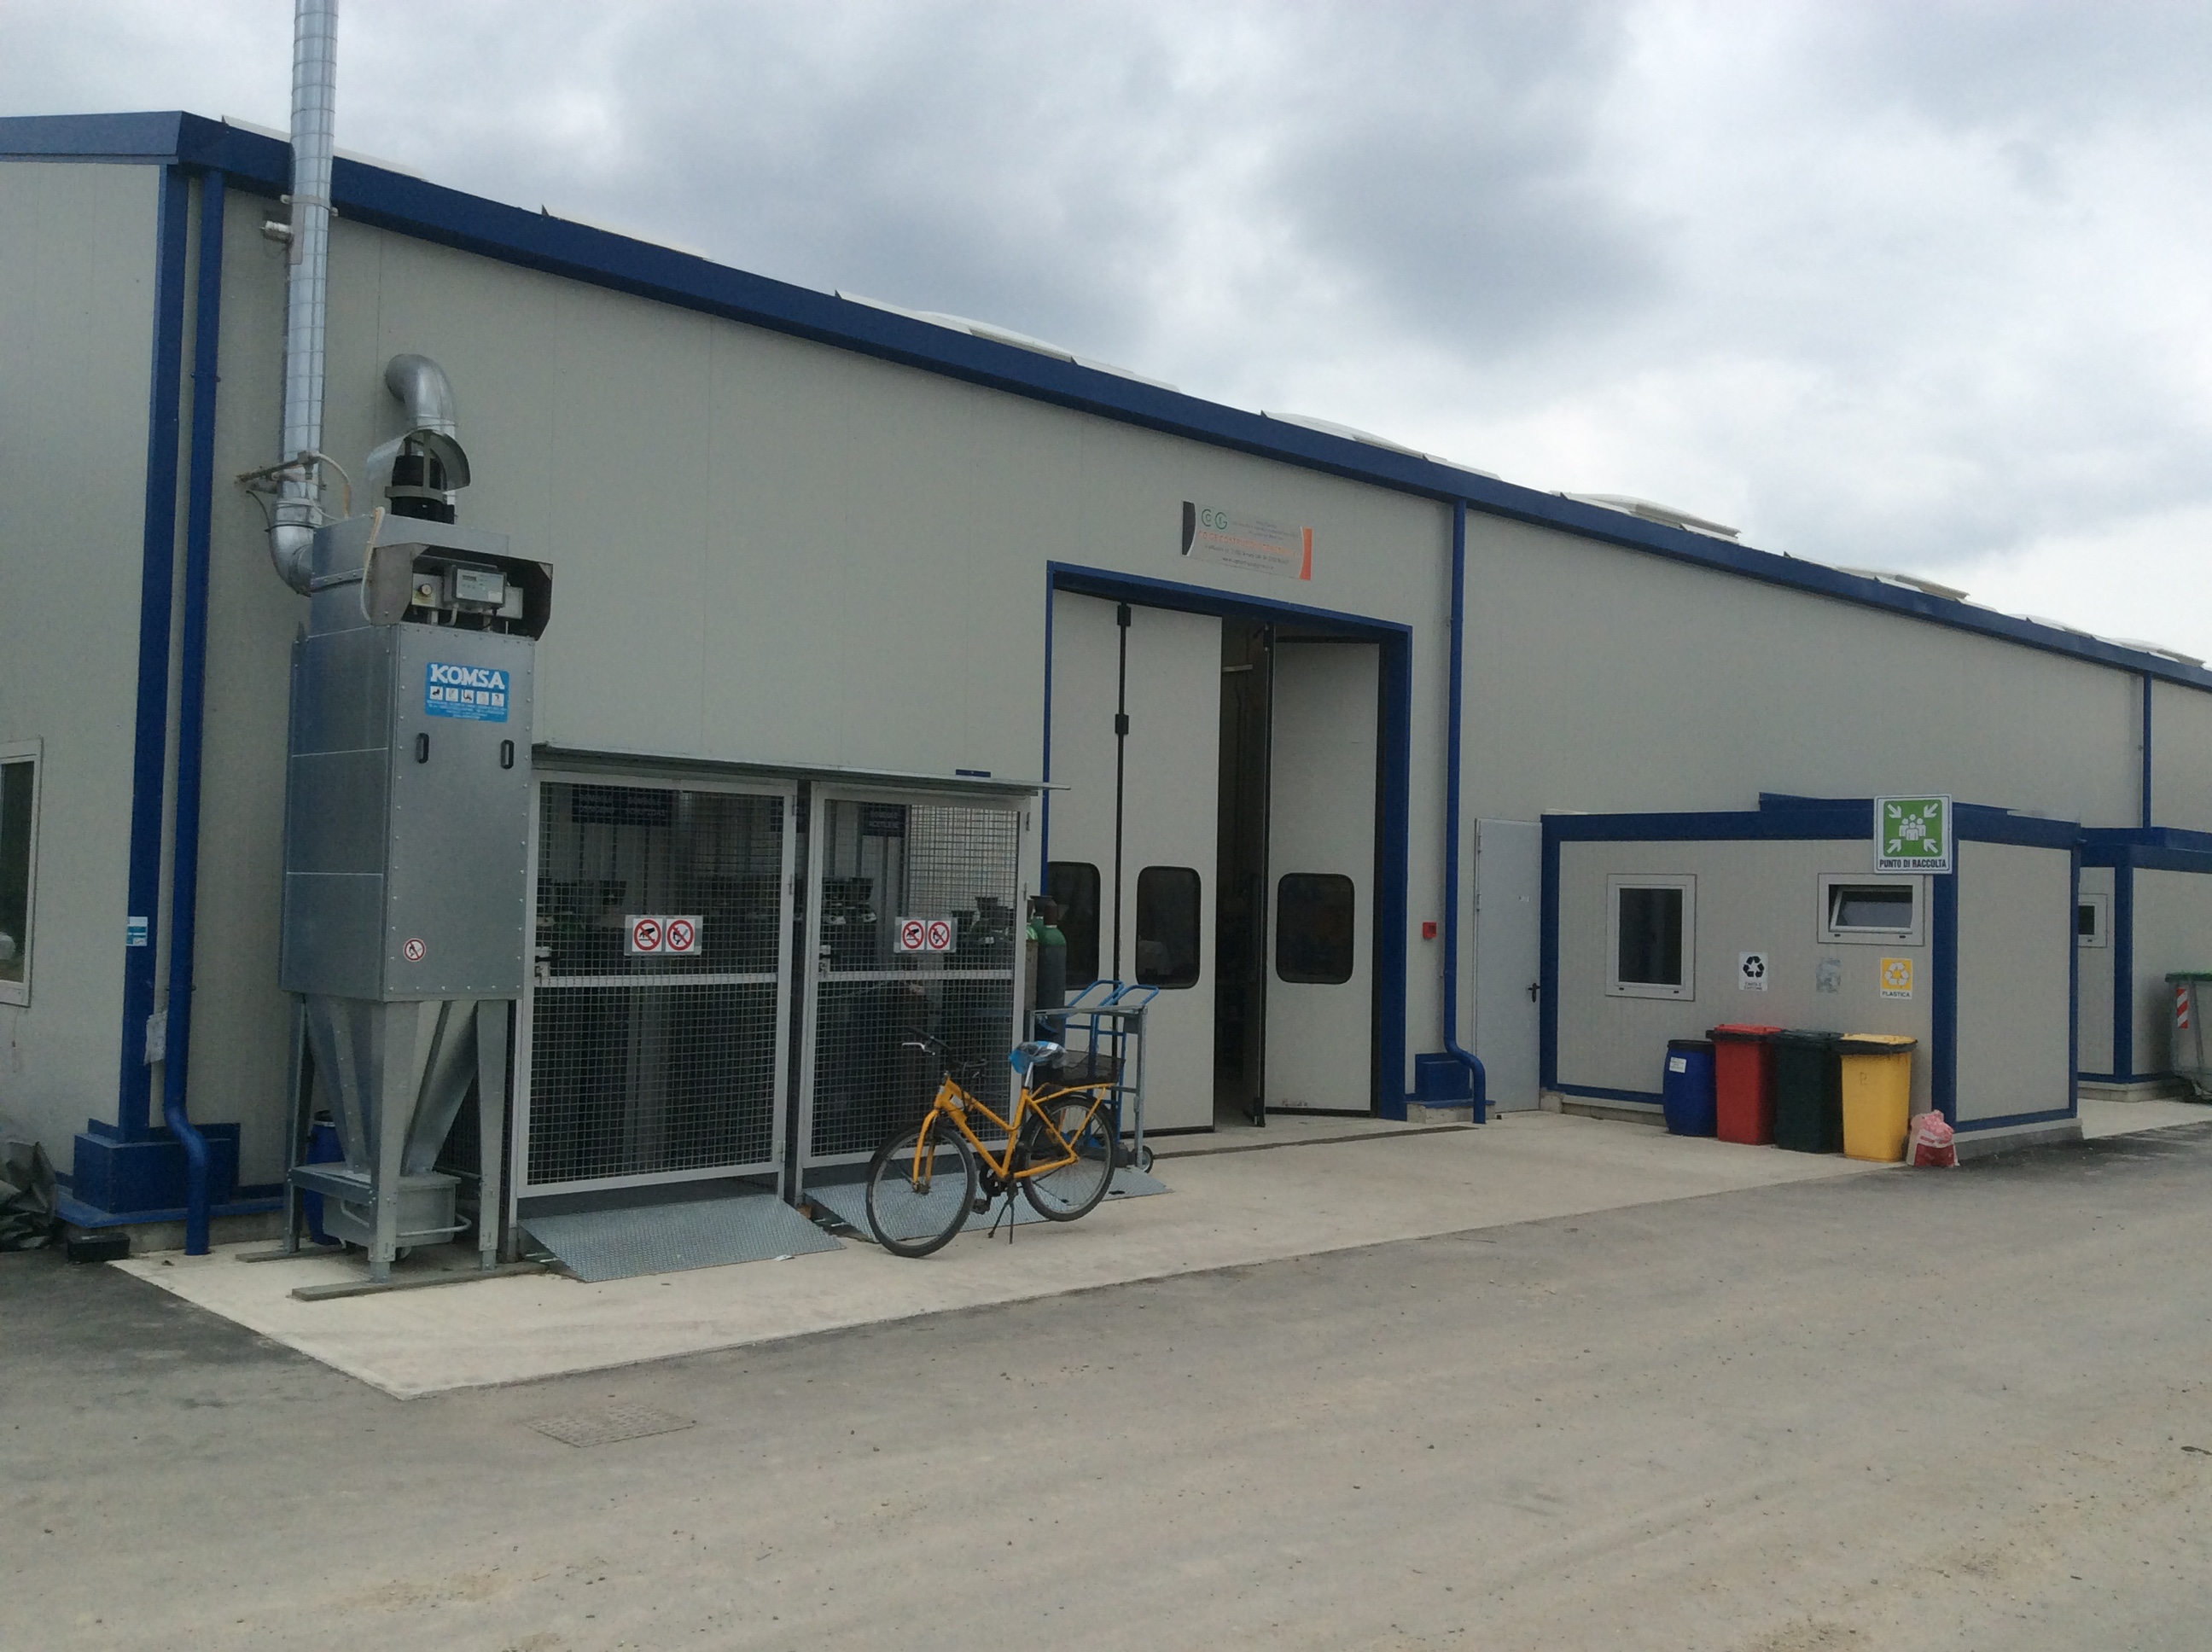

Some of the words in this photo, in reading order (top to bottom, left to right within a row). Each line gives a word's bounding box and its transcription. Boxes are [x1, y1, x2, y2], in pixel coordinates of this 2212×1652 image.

[430, 663, 505, 689] KOMSA
[1880, 859, 1901, 868] PUNTO
[1903, 859, 1911, 868] DI
[1912, 859, 1947, 868] RACCOLTA
